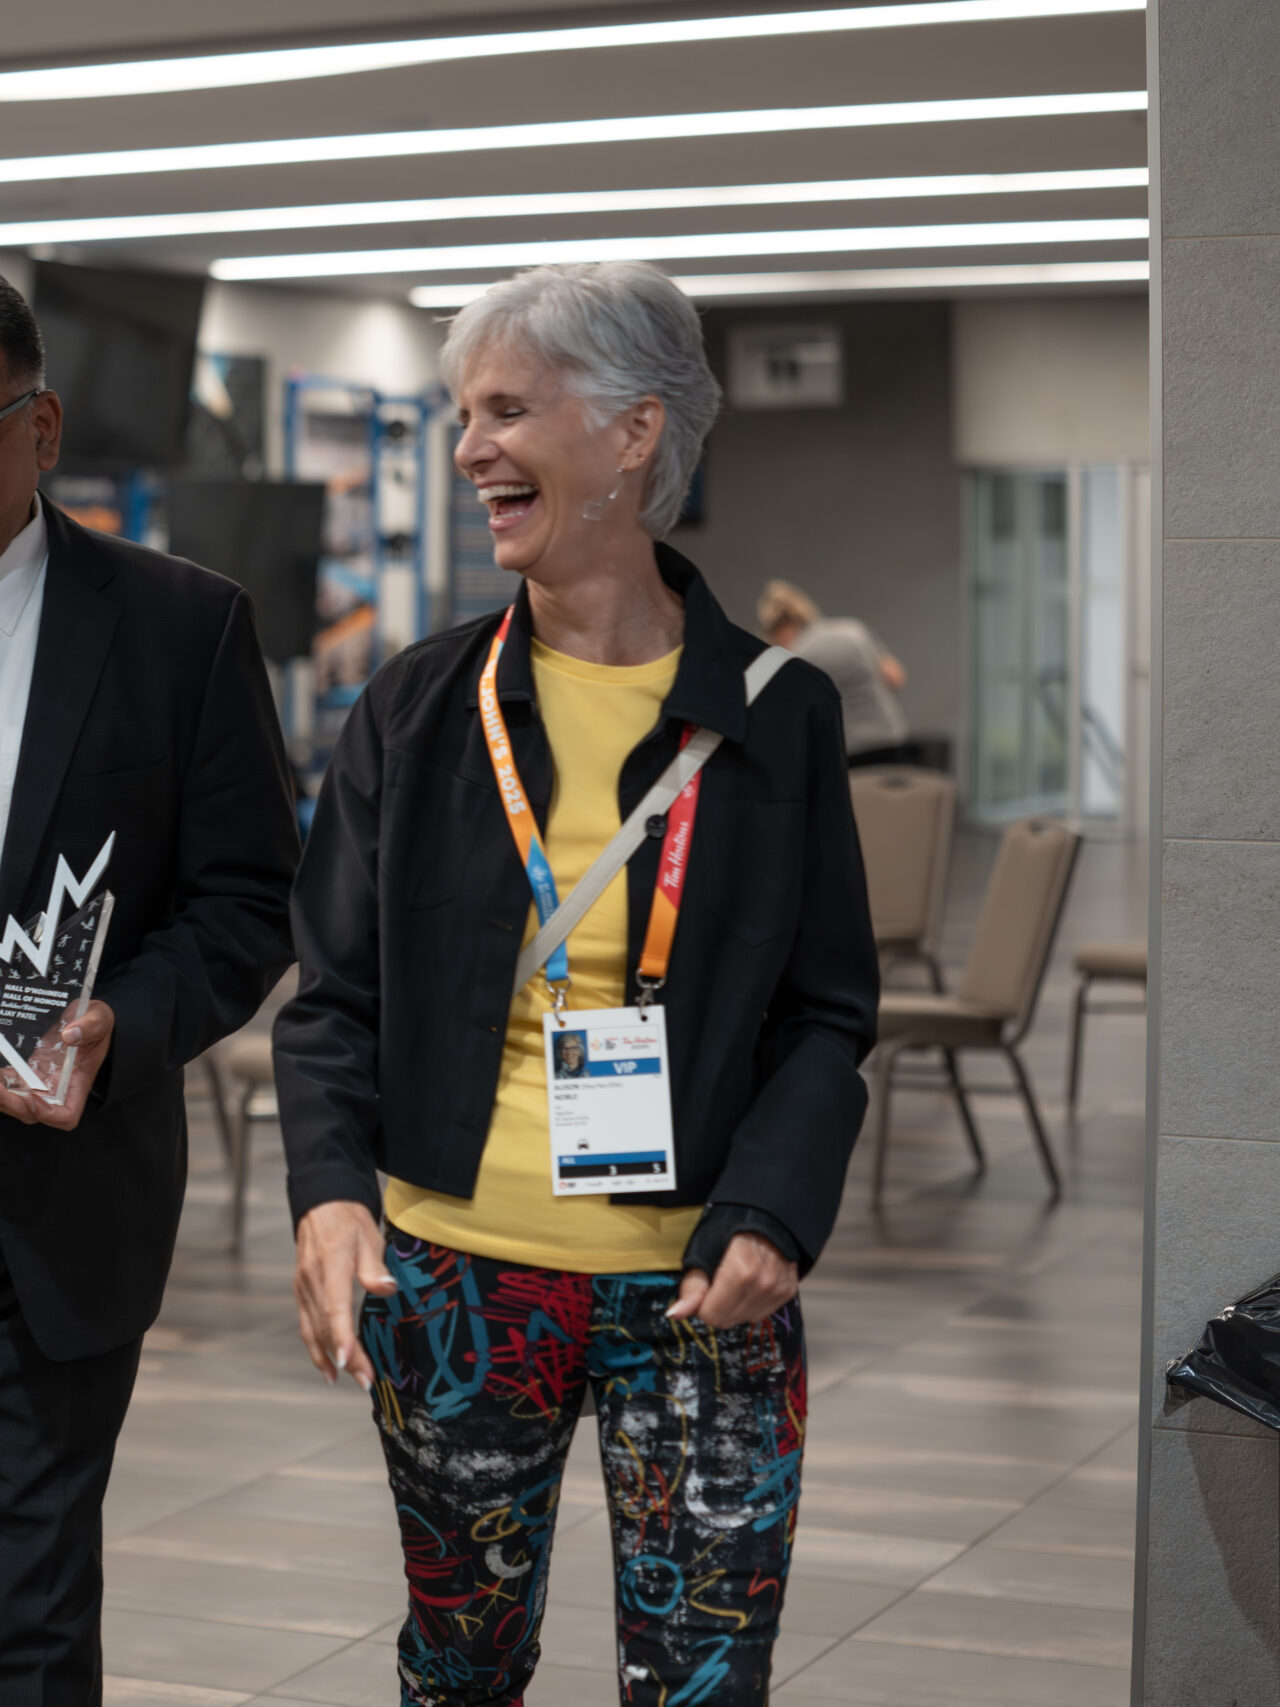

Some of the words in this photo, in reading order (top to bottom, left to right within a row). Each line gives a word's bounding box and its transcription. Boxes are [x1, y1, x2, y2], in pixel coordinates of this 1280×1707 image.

[497, 764, 527, 815] 2025
[667, 822, 689, 866] Hortons
[663, 866, 681, 888] Tim
[4, 984, 23, 992] HALL
[2, 992, 22, 1001] HALL
[33, 996, 68, 1007] HONOUR
[16, 1011, 37, 1020] PATEL
[613, 1061, 638, 1074] VIP
[609, 1164, 618, 1176] 3
[652, 1162, 661, 1173] 5
